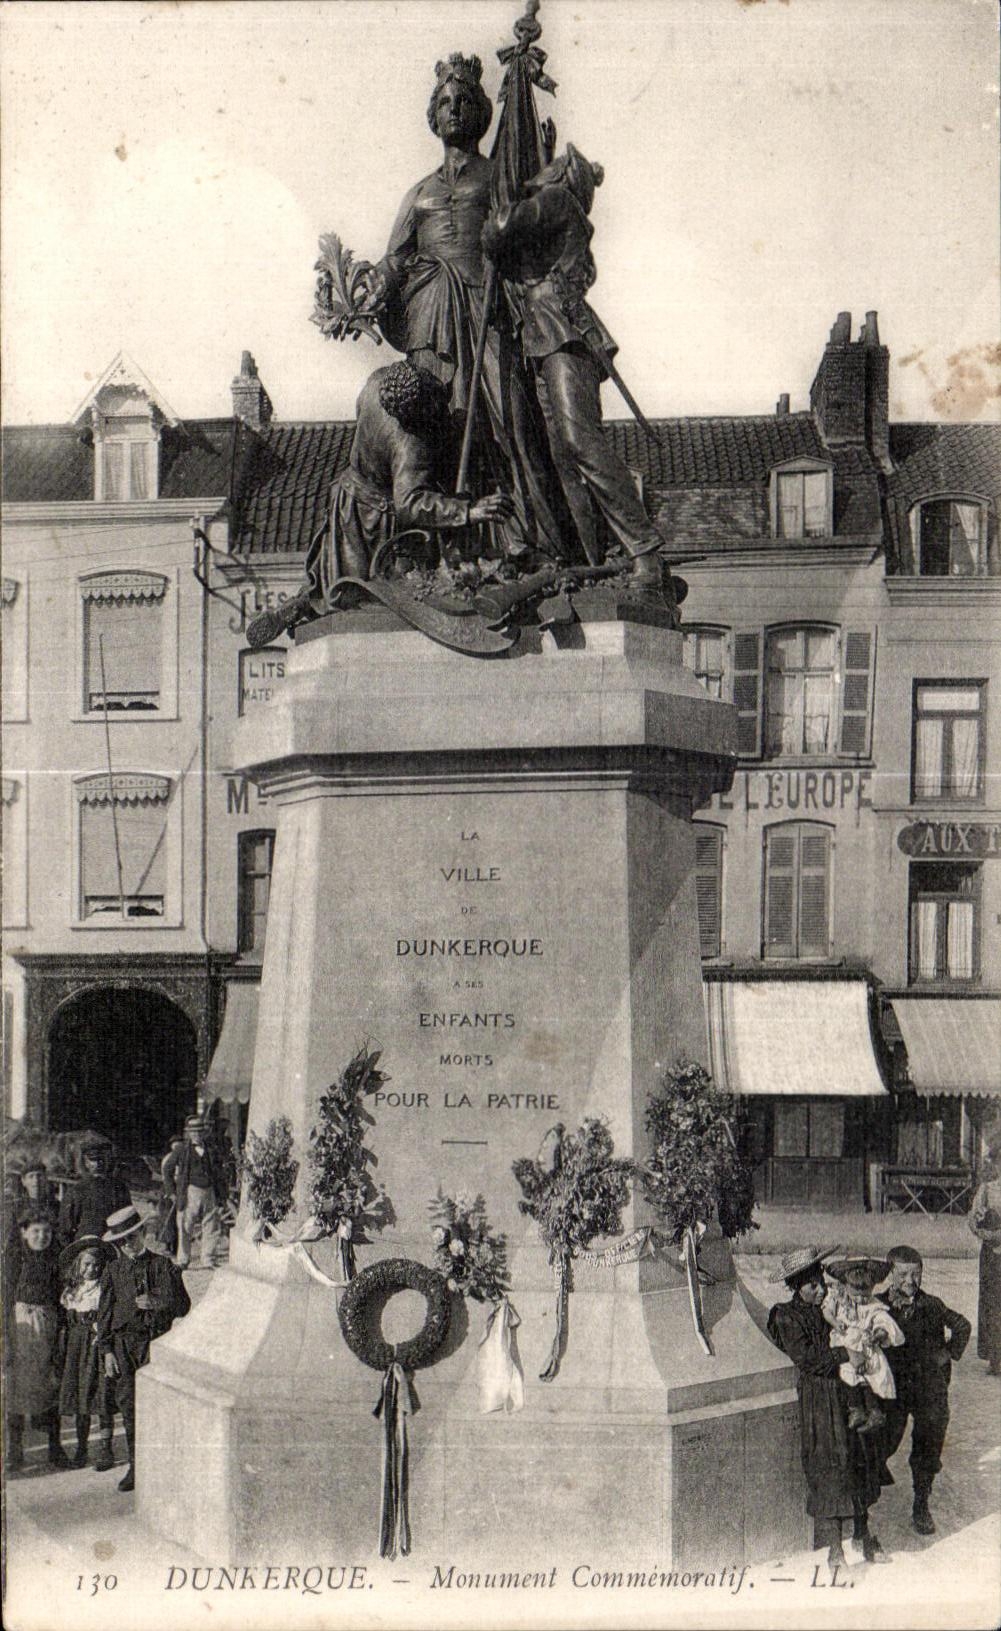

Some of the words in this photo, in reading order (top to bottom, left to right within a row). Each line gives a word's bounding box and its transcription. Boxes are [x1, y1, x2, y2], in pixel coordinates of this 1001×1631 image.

[249, 662, 285, 678] LITS
[460, 832, 480, 841] LA
[921, 824, 973, 852] AUX
[440, 867, 501, 882] VILLE
[461, 906, 477, 915] DE
[396, 939, 544, 958] DUNKERQUE
[465, 981, 484, 989] SES
[419, 1013, 516, 1028] ENFANTS
[440, 1054, 494, 1066] MORTS
[374, 1092, 430, 1108] POUR
[444, 1093, 473, 1108] LA
[487, 1093, 560, 1110] PATRIE
